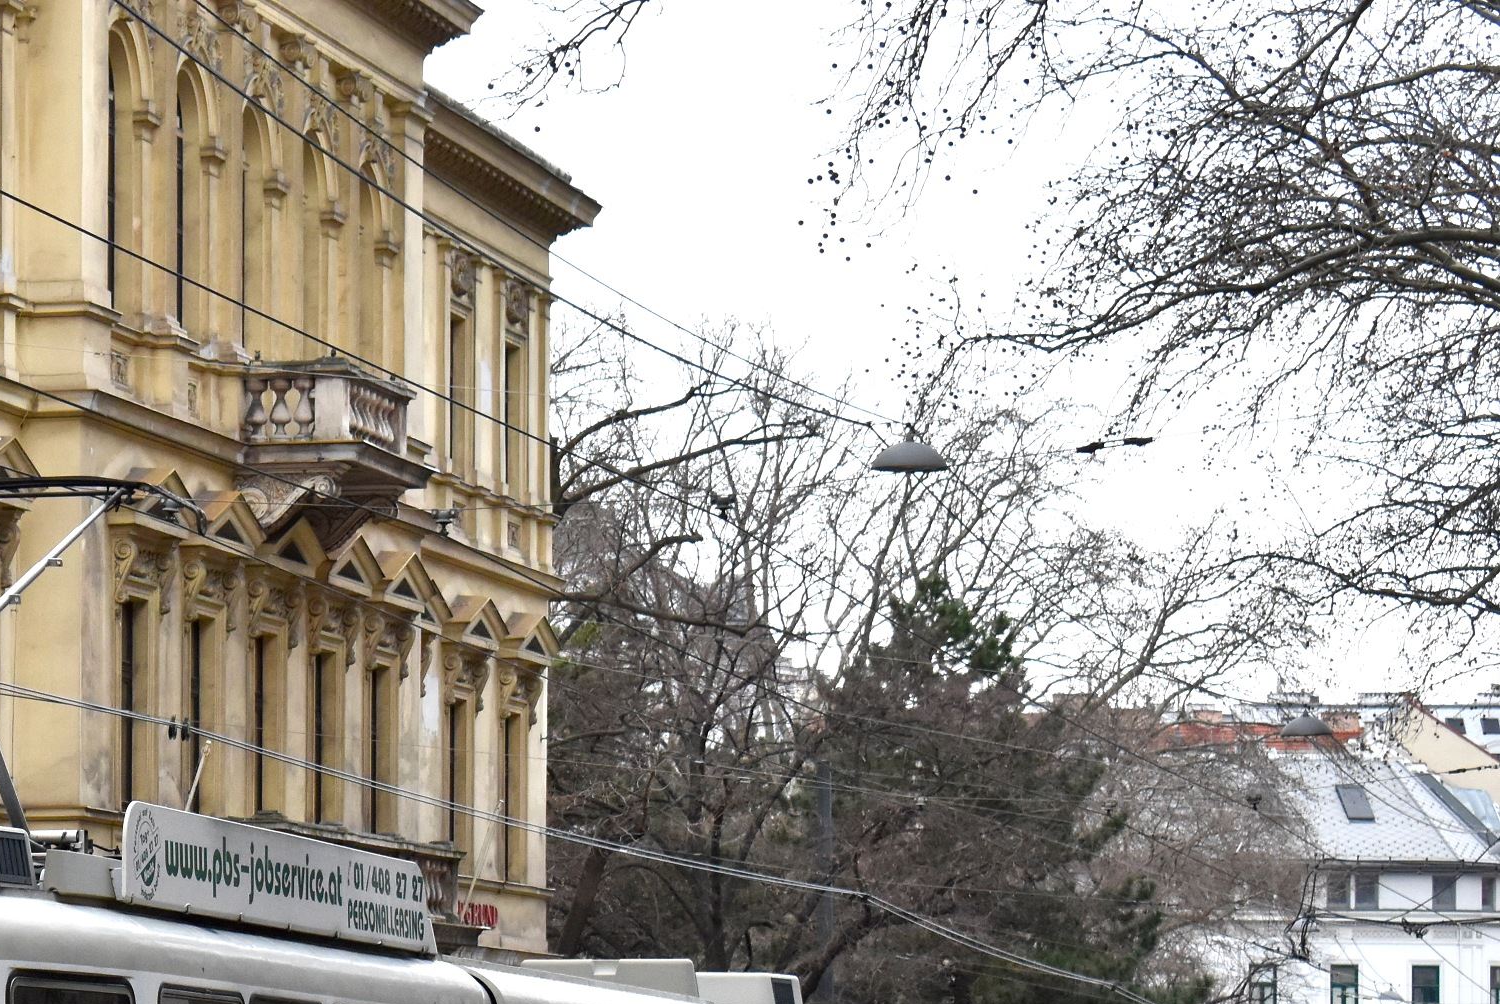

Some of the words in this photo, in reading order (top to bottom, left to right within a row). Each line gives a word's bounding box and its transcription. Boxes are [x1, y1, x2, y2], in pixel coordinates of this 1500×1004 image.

[164, 836, 343, 906] www.pbs-jobservice.at
[395, 871, 407, 899] 27
[412, 874, 424, 902] 27
[347, 898, 425, 941] PERSONALLEASING
